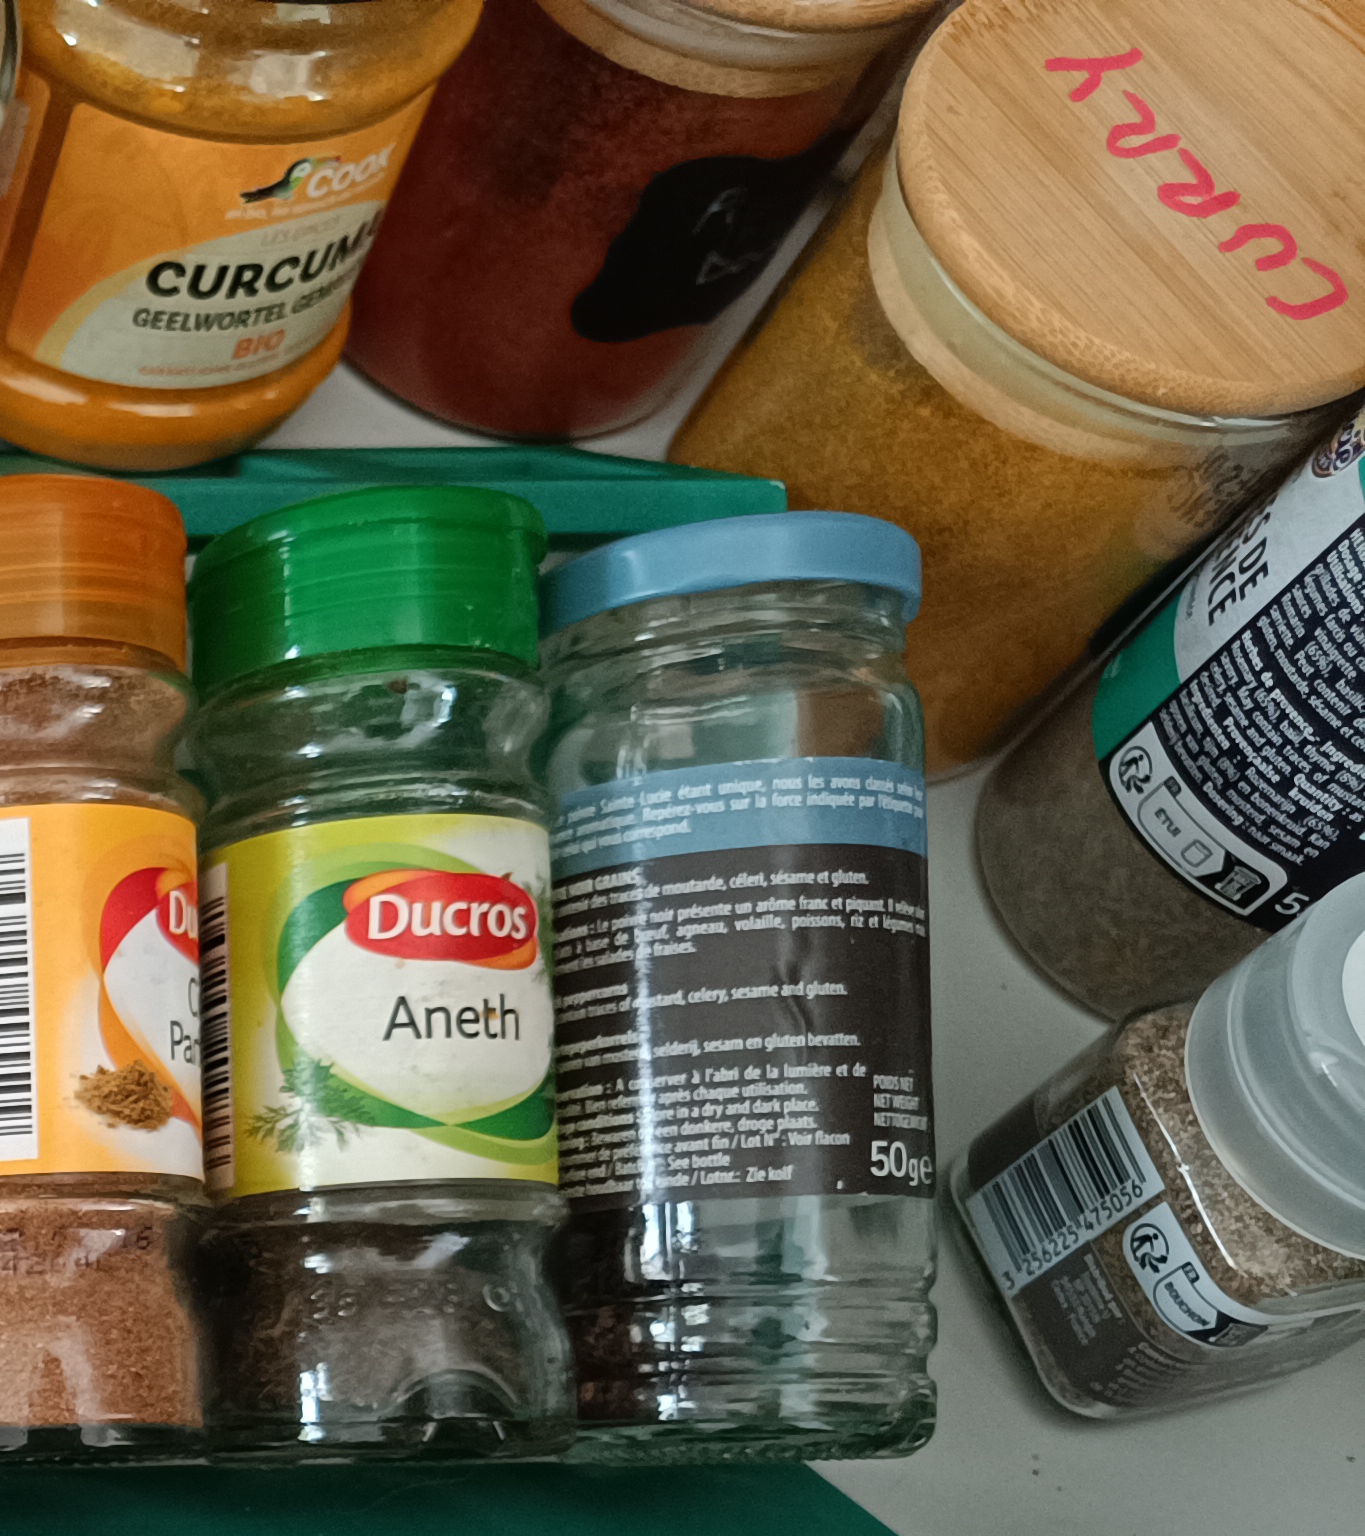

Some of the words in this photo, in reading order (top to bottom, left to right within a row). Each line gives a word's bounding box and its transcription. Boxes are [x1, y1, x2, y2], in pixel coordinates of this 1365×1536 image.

[1044, 46, 1350, 321] CURRY
[132, 302, 288, 333] GEELWORTEL
[231, 329, 286, 360] BIO
[1250, 708, 1285, 747] contain
[1280, 743, 1312, 775] traces
[1245, 724, 1266, 747] and
[1290, 769, 1345, 816] Quantity
[368, 893, 527, 940] Ducros
[382, 994, 521, 1042] Aneth
[1004, 1272, 1016, 1290] 3
[1021, 1227, 1080, 1276] 256225
[1084, 1180, 1144, 1236] 475056
[1163, 1282, 1211, 1327] BOUCHON
